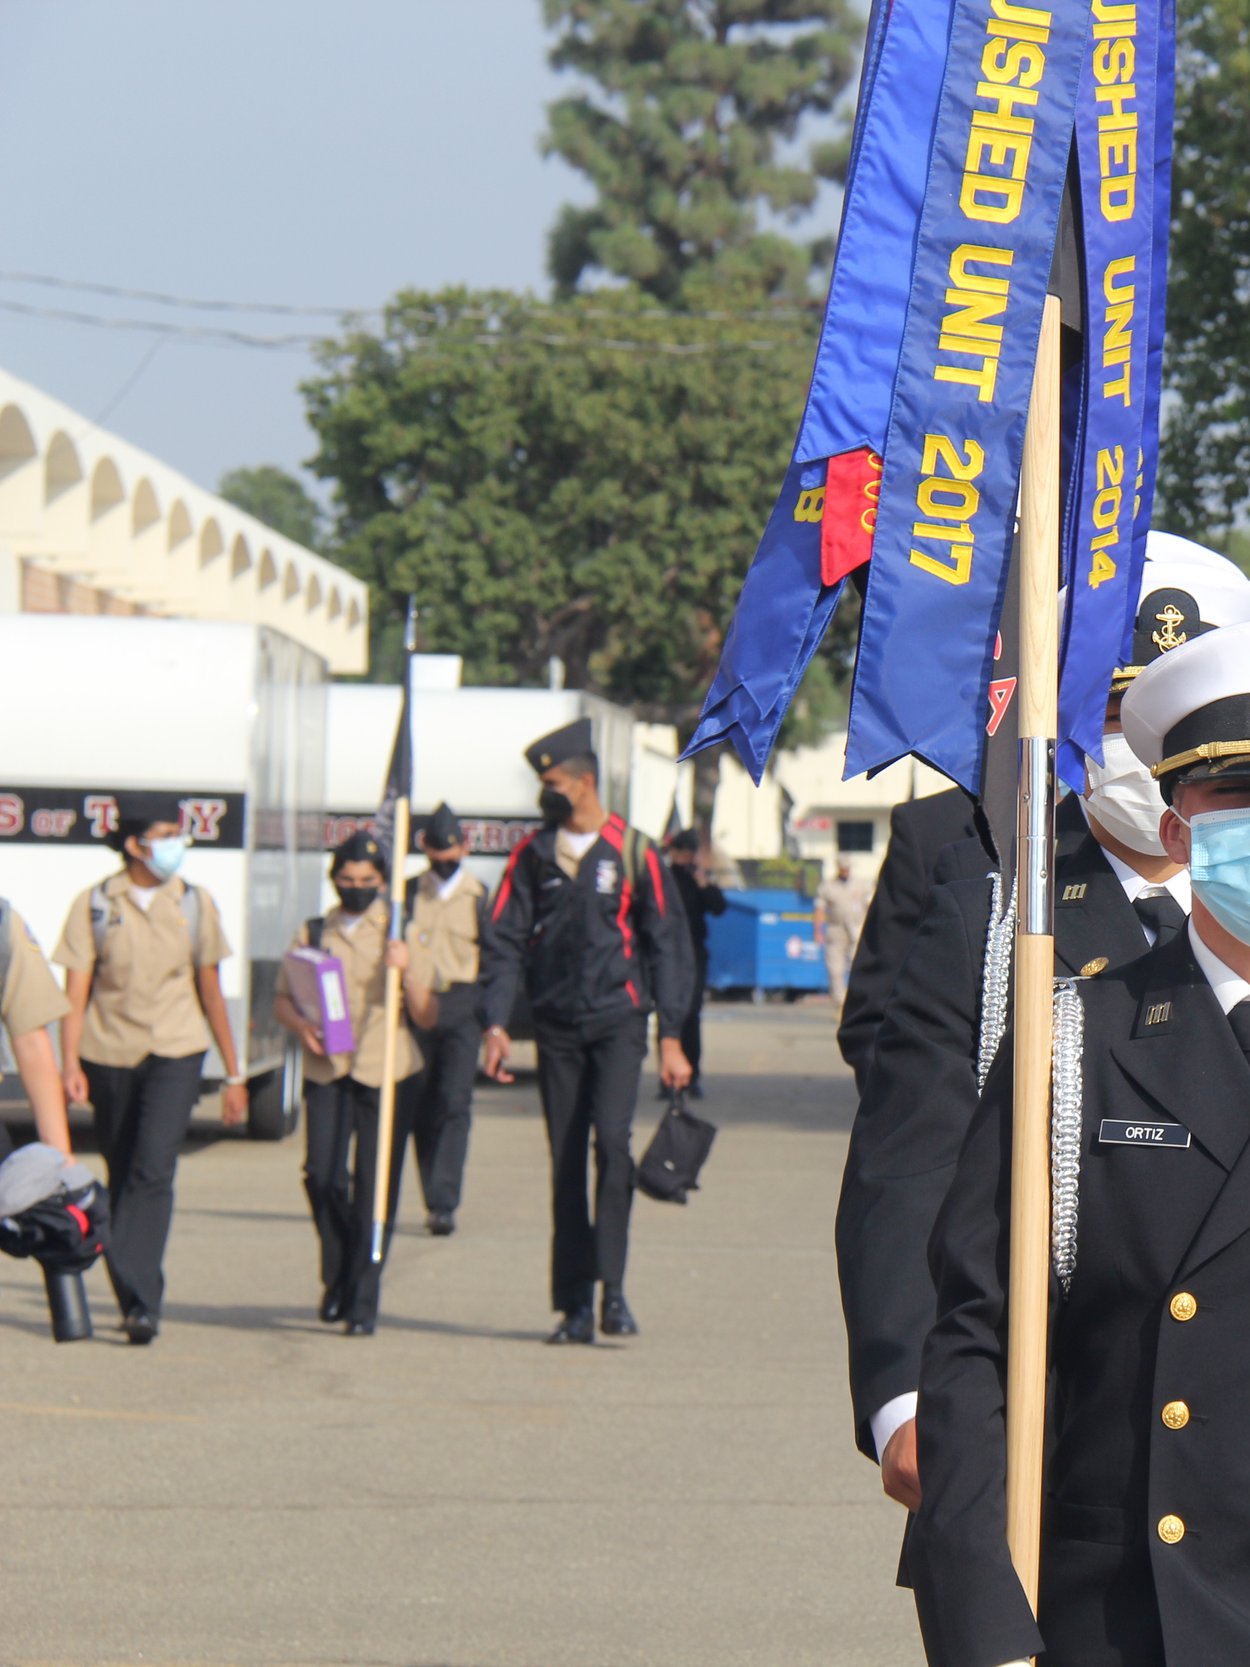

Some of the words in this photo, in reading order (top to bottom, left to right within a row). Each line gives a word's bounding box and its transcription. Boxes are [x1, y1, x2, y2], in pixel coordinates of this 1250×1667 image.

[934, 243, 1014, 403] UNIT
[1103, 255, 1136, 408] UNIT
[909, 433, 985, 587] 2017
[1088, 445, 1124, 590] 2014
[84, 795, 227, 840] TY
[1125, 1126, 1165, 1141] ORTIZ
